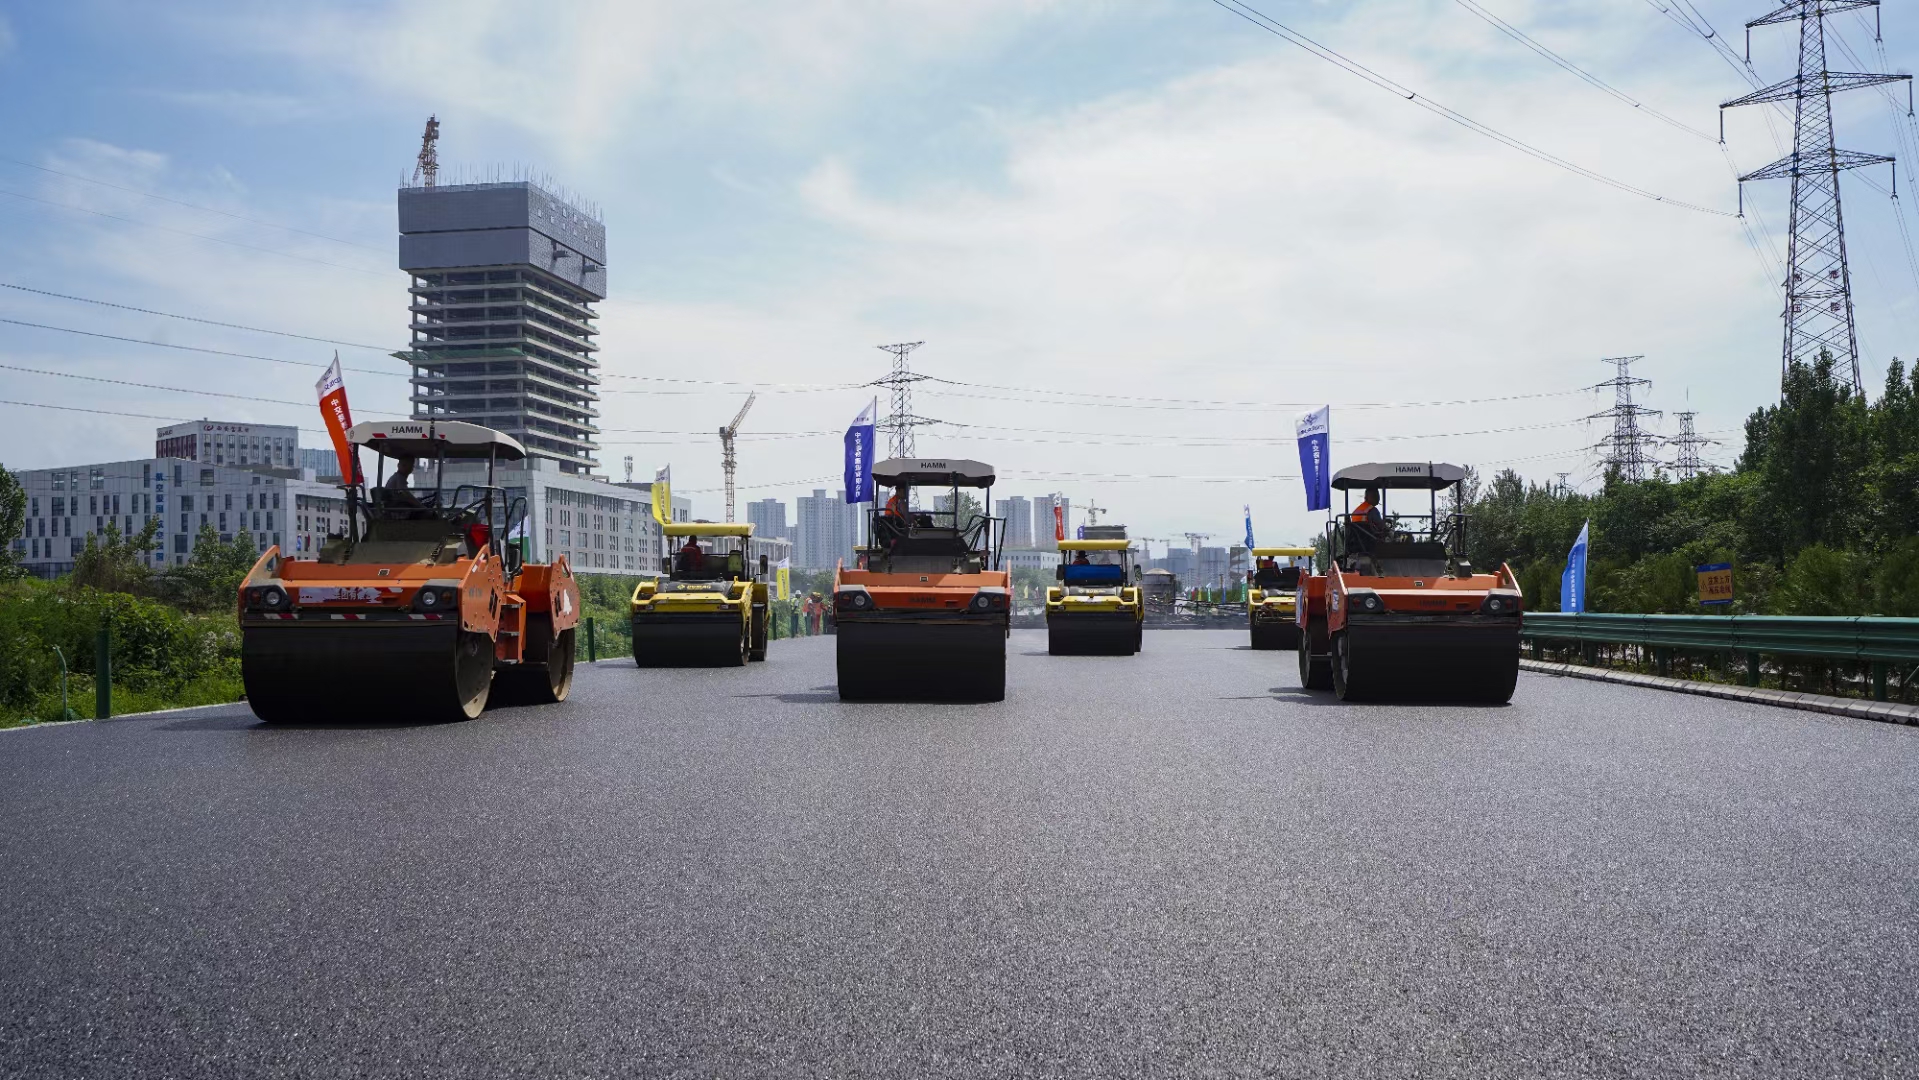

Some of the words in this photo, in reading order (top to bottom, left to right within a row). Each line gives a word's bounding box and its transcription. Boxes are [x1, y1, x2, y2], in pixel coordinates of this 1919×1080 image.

[391, 426, 423, 434] HAMM
[1707, 575, 1731, 585] 注意上方
[1708, 584, 1732, 594] 高压电线
